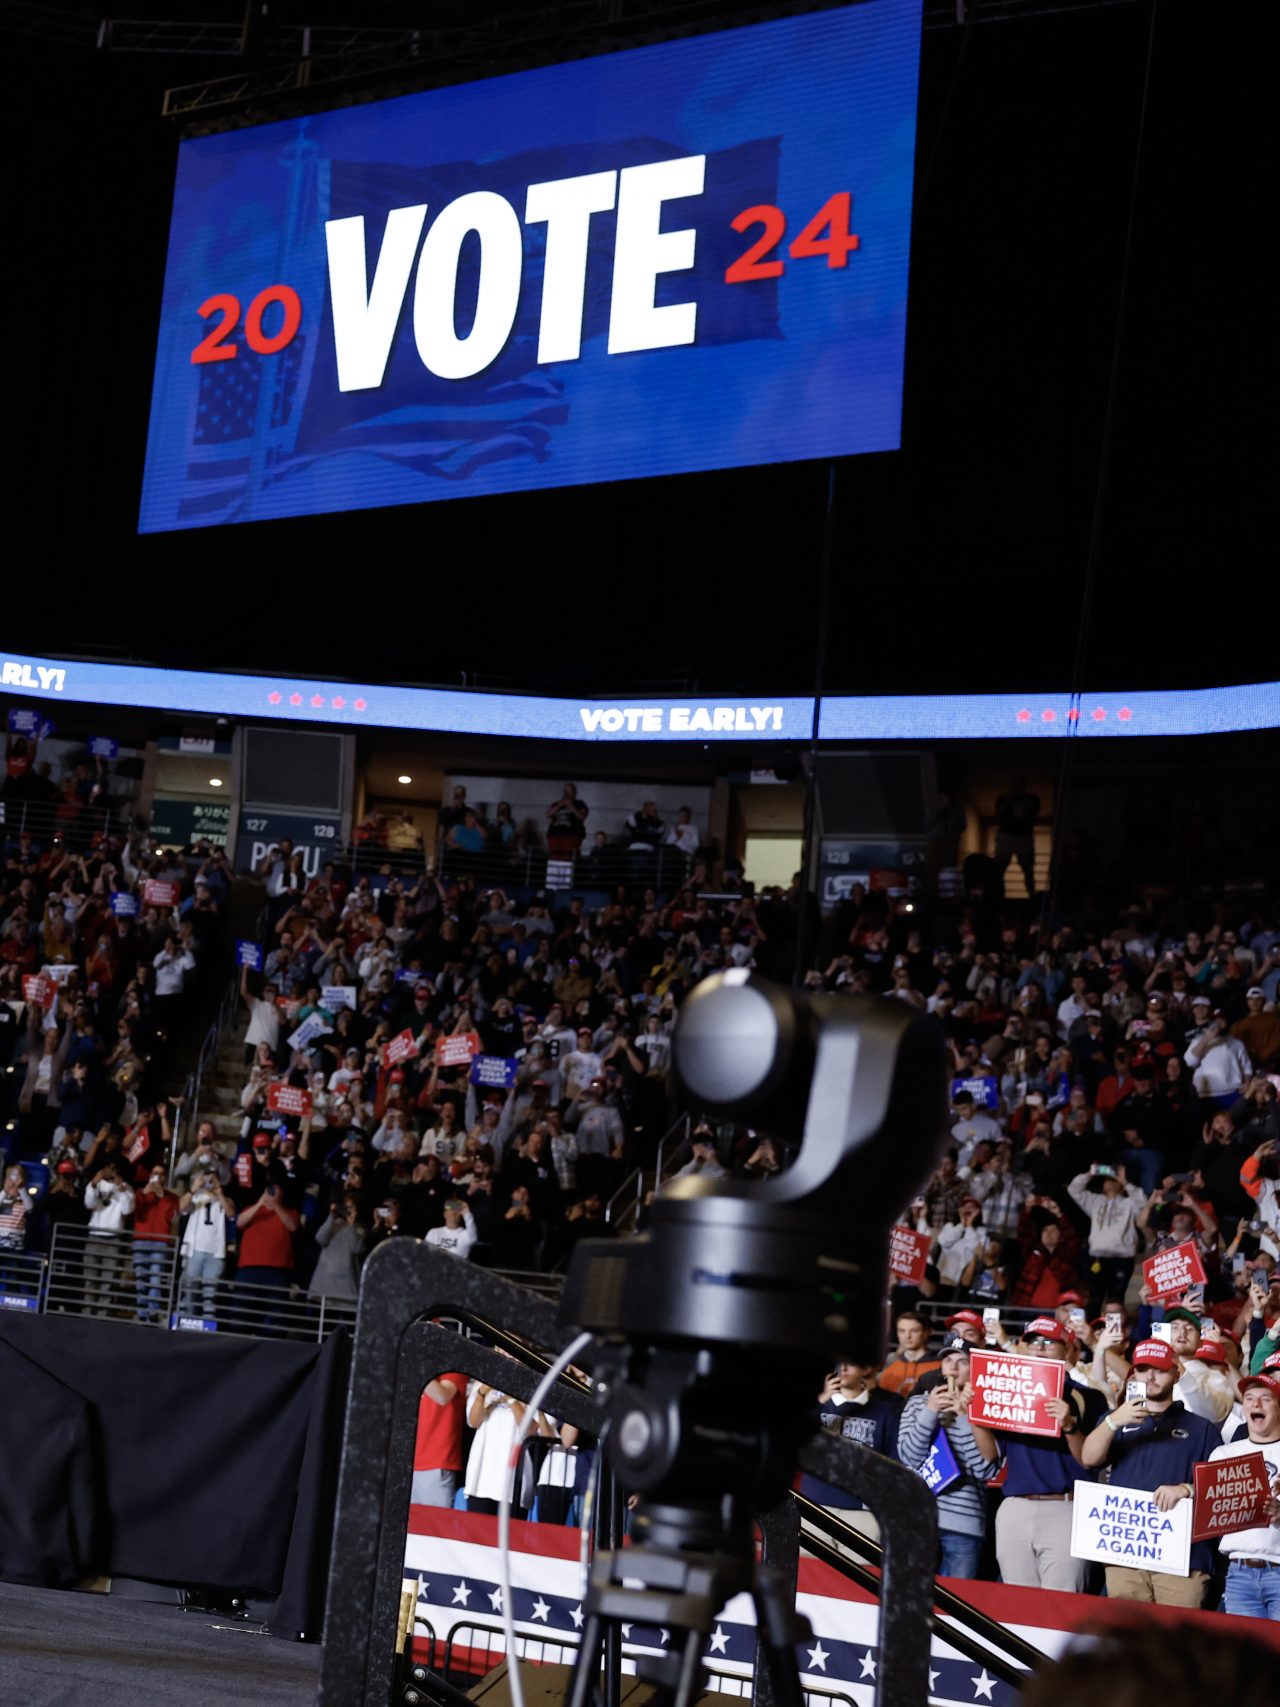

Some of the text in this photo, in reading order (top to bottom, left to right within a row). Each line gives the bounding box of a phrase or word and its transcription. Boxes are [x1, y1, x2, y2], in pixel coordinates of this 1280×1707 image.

[191, 154, 859, 393] 20 VOTE 24
[580, 707, 784, 732] VOTE EARLY!
[246, 819, 268, 832] 127
[314, 825, 335, 838] 128
[1148, 1256, 1192, 1279] AMERICA
[1154, 1249, 1181, 1267] MAKE
[1154, 1265, 1188, 1284] GREAT
[1157, 1273, 1193, 1293] AGAIN!
[1136, 1350, 1166, 1359] GREAT AGAIN
[1147, 1343, 1168, 1353] AMERICA
[986, 1361, 1033, 1380] MAKE
[976, 1374, 1047, 1397] AMERICA
[982, 1389, 1036, 1408] GREAT
[982, 1403, 1036, 1424] AGAIN!
[1216, 1462, 1252, 1483] MAKE
[1205, 1477, 1263, 1500] AMERICA
[1105, 1495, 1158, 1514] MAKE
[1212, 1494, 1258, 1513] GREAT
[1088, 1507, 1173, 1532] AMERICA
[1207, 1508, 1257, 1528] AGAIN!
[1099, 1523, 1162, 1545] GREAT
[1096, 1538, 1162, 1560] AGAIN!
